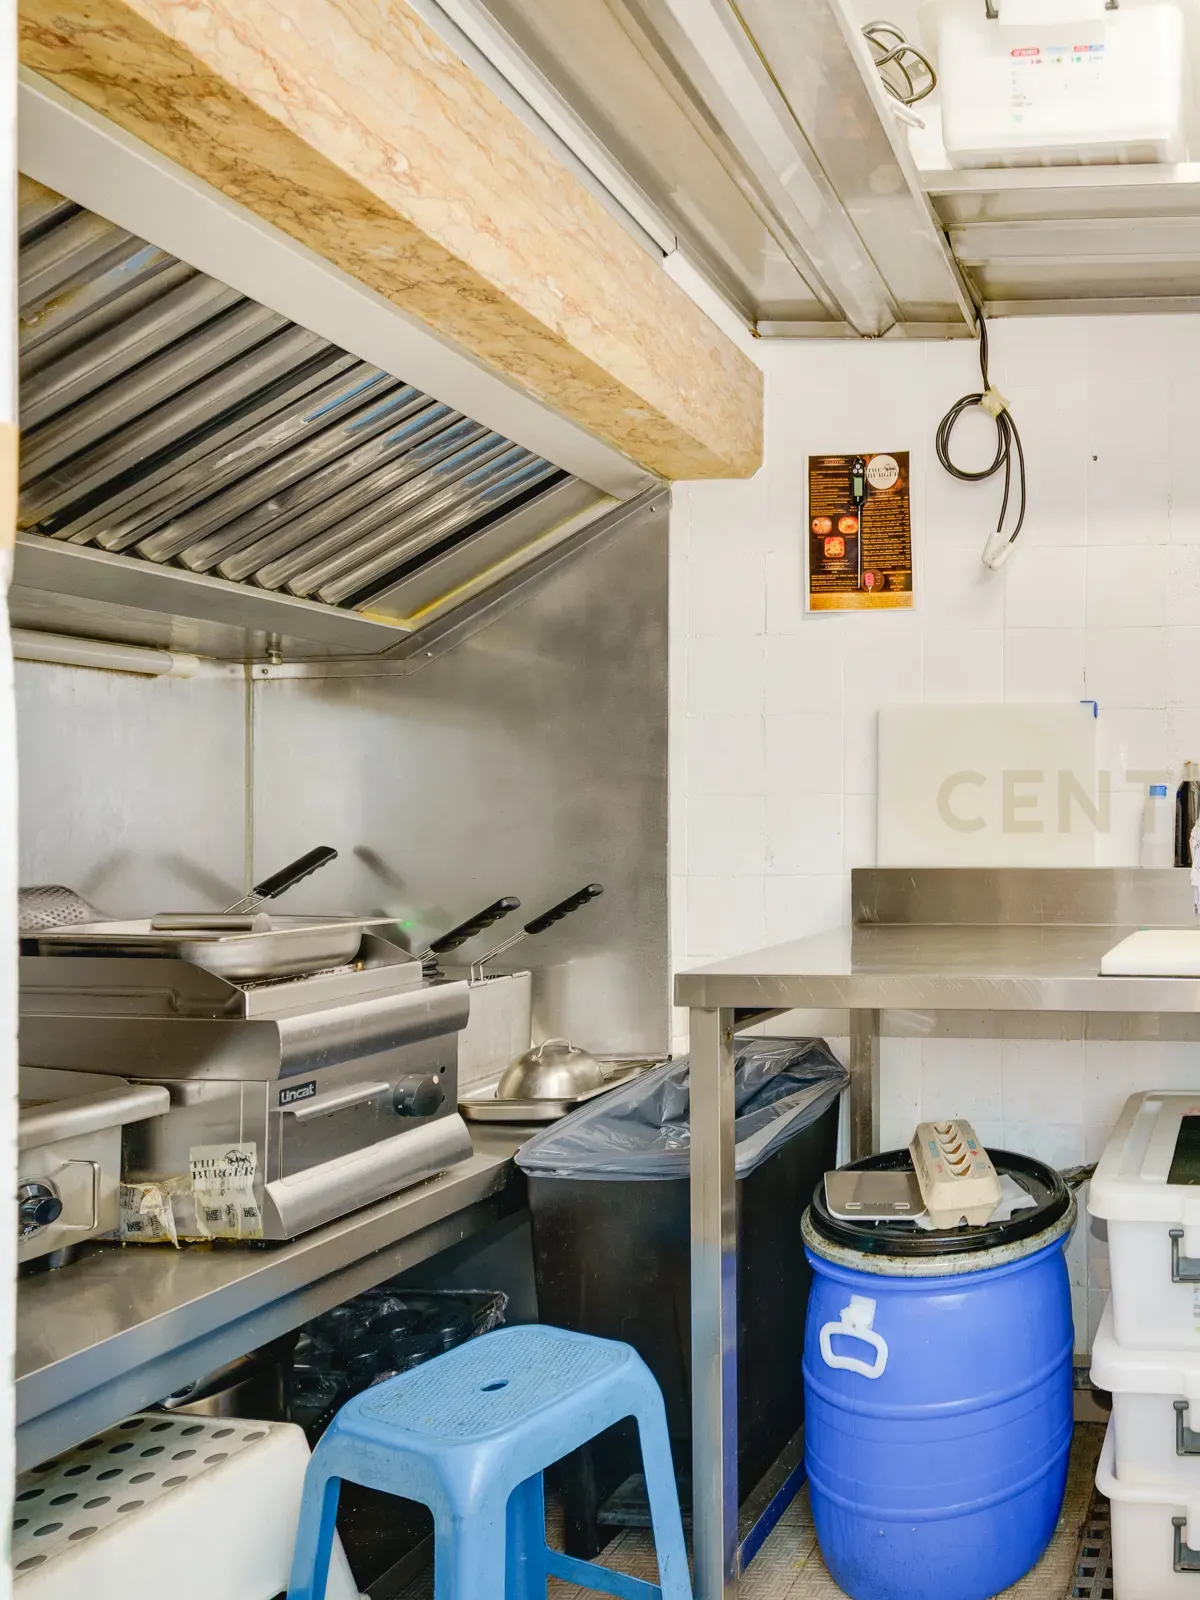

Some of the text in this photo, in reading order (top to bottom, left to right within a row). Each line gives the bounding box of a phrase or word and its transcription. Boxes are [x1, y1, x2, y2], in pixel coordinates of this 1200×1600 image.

[281, 1084, 314, 1103] Lincat
[190, 1159, 220, 1168] THE
[192, 1167, 254, 1181] BURGER
